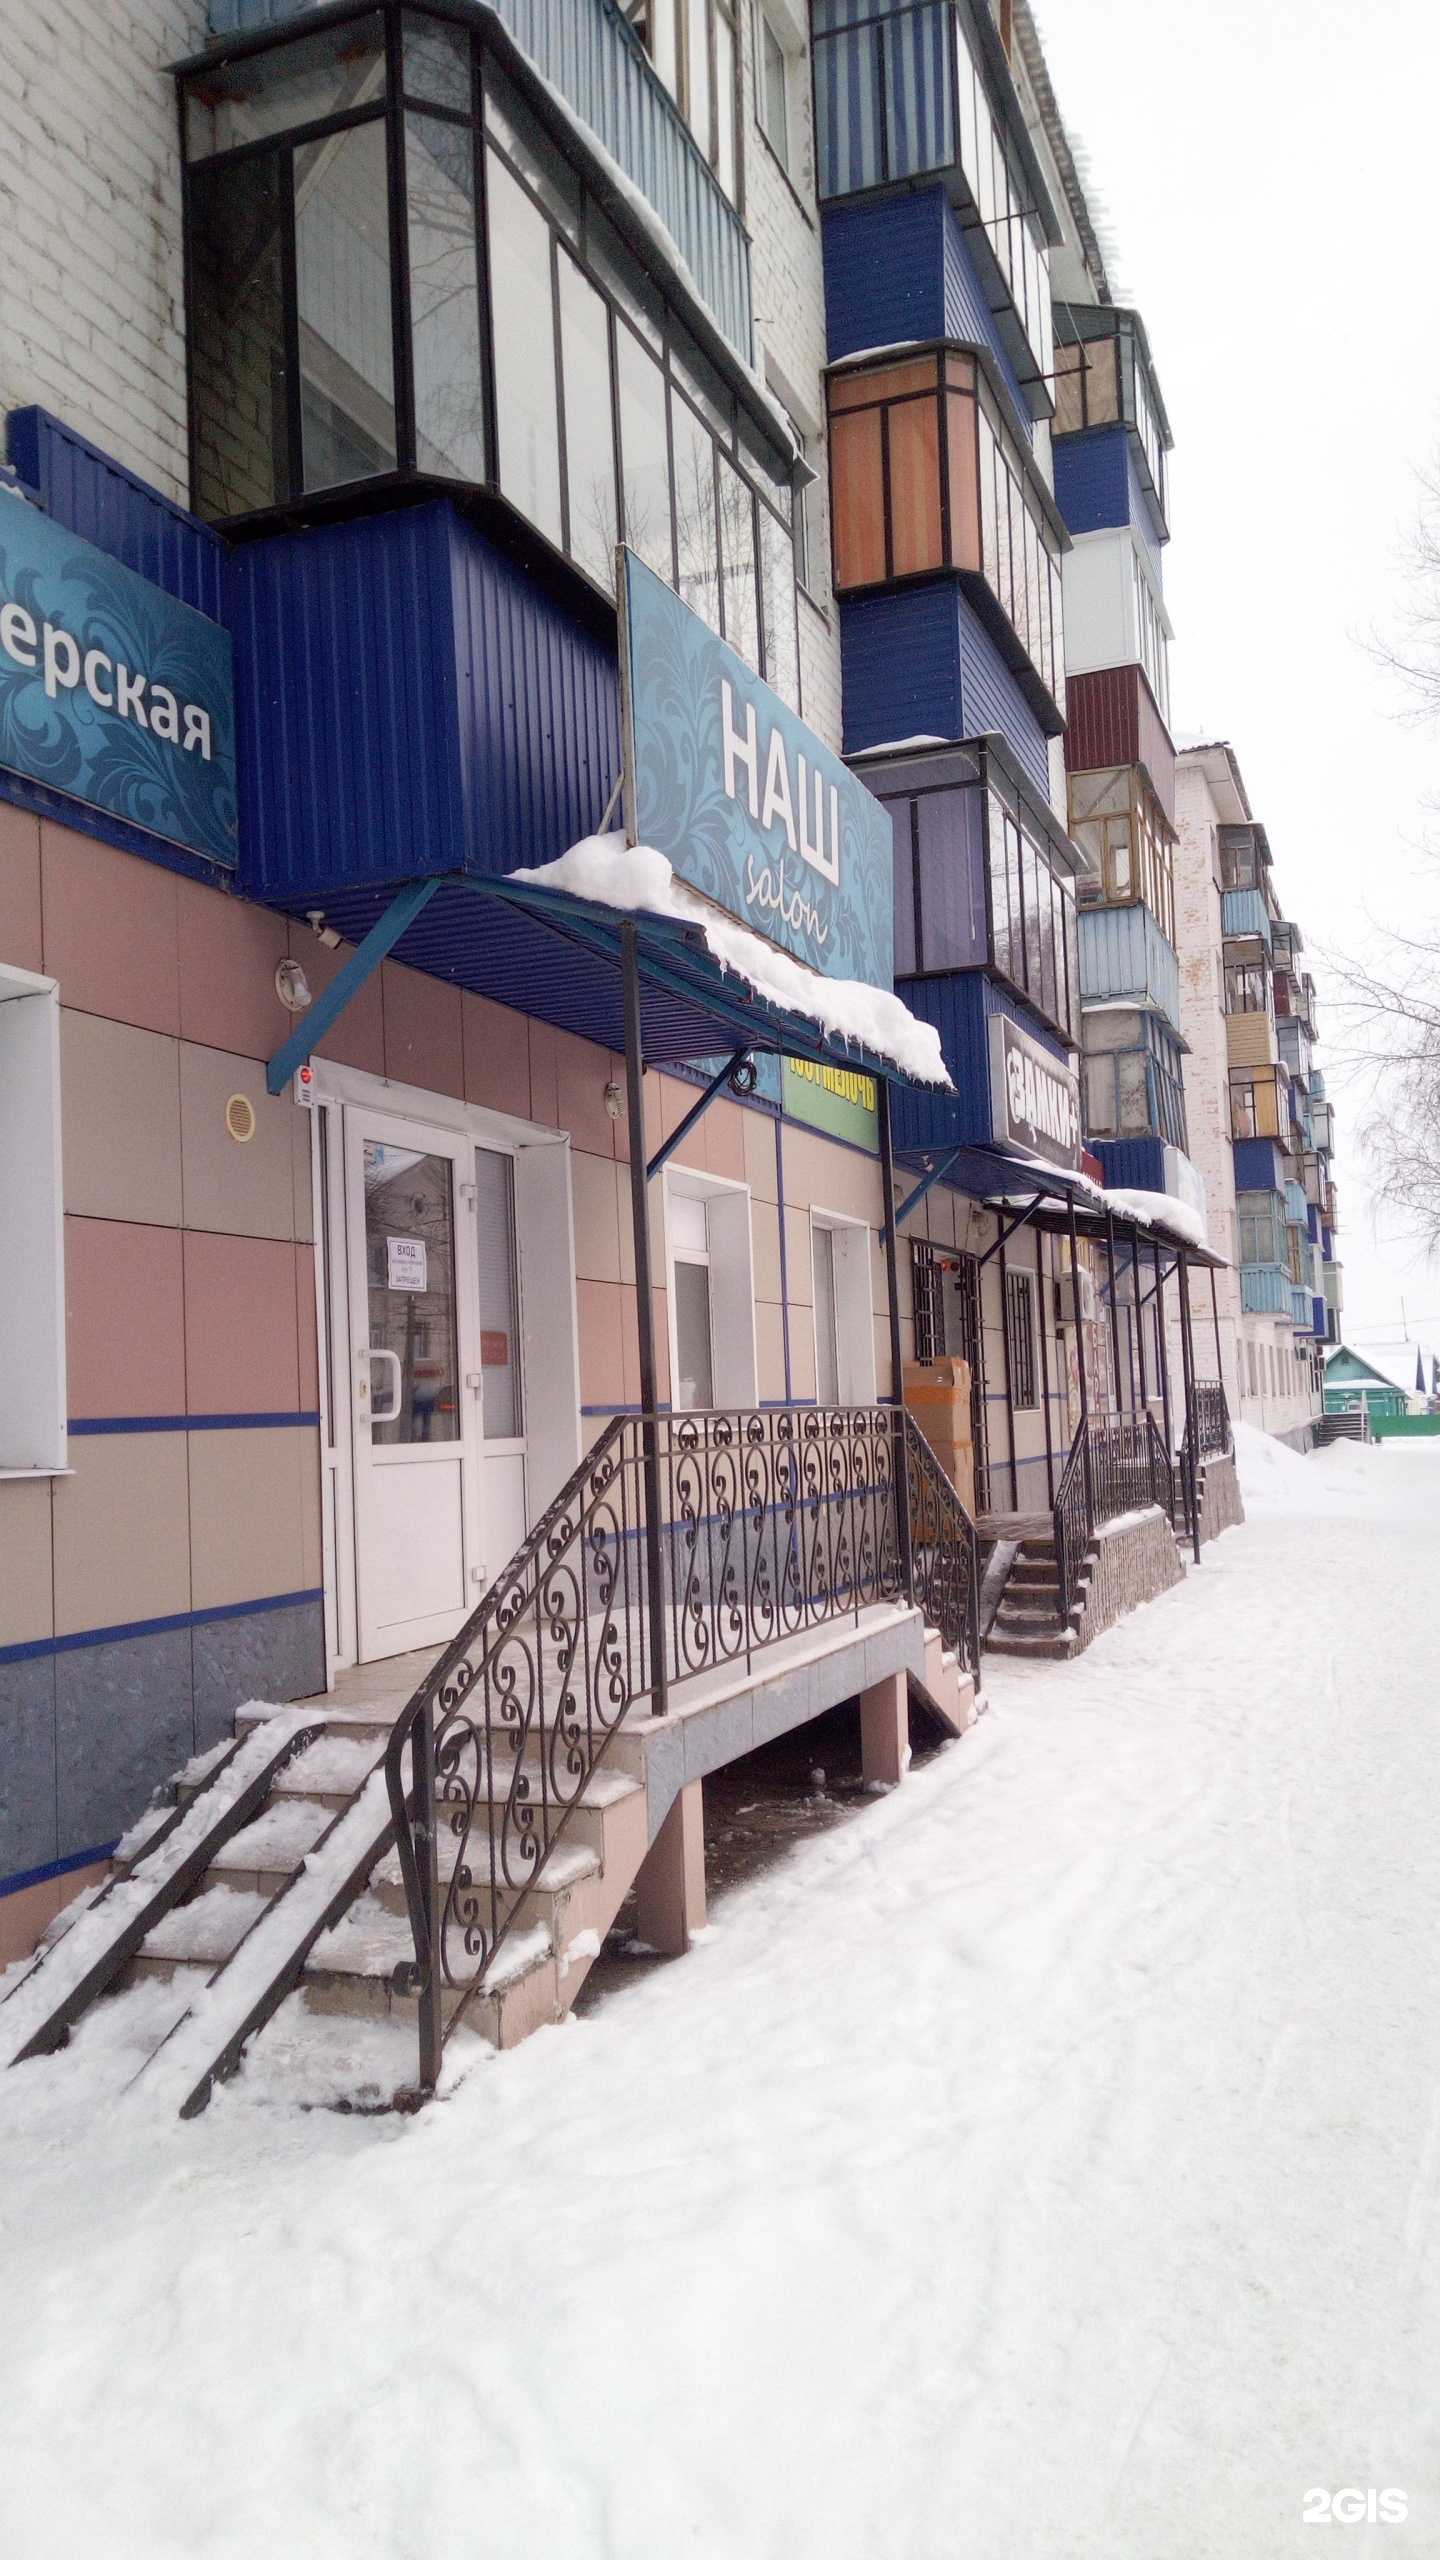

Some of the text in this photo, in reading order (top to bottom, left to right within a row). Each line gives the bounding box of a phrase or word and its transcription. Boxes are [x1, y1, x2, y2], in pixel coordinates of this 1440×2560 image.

[0, 602, 211, 761] ерская
[721, 678, 840, 887] НАШ
[746, 854, 828, 944] salon
[397, 1244, 416, 1258] ВХОД
